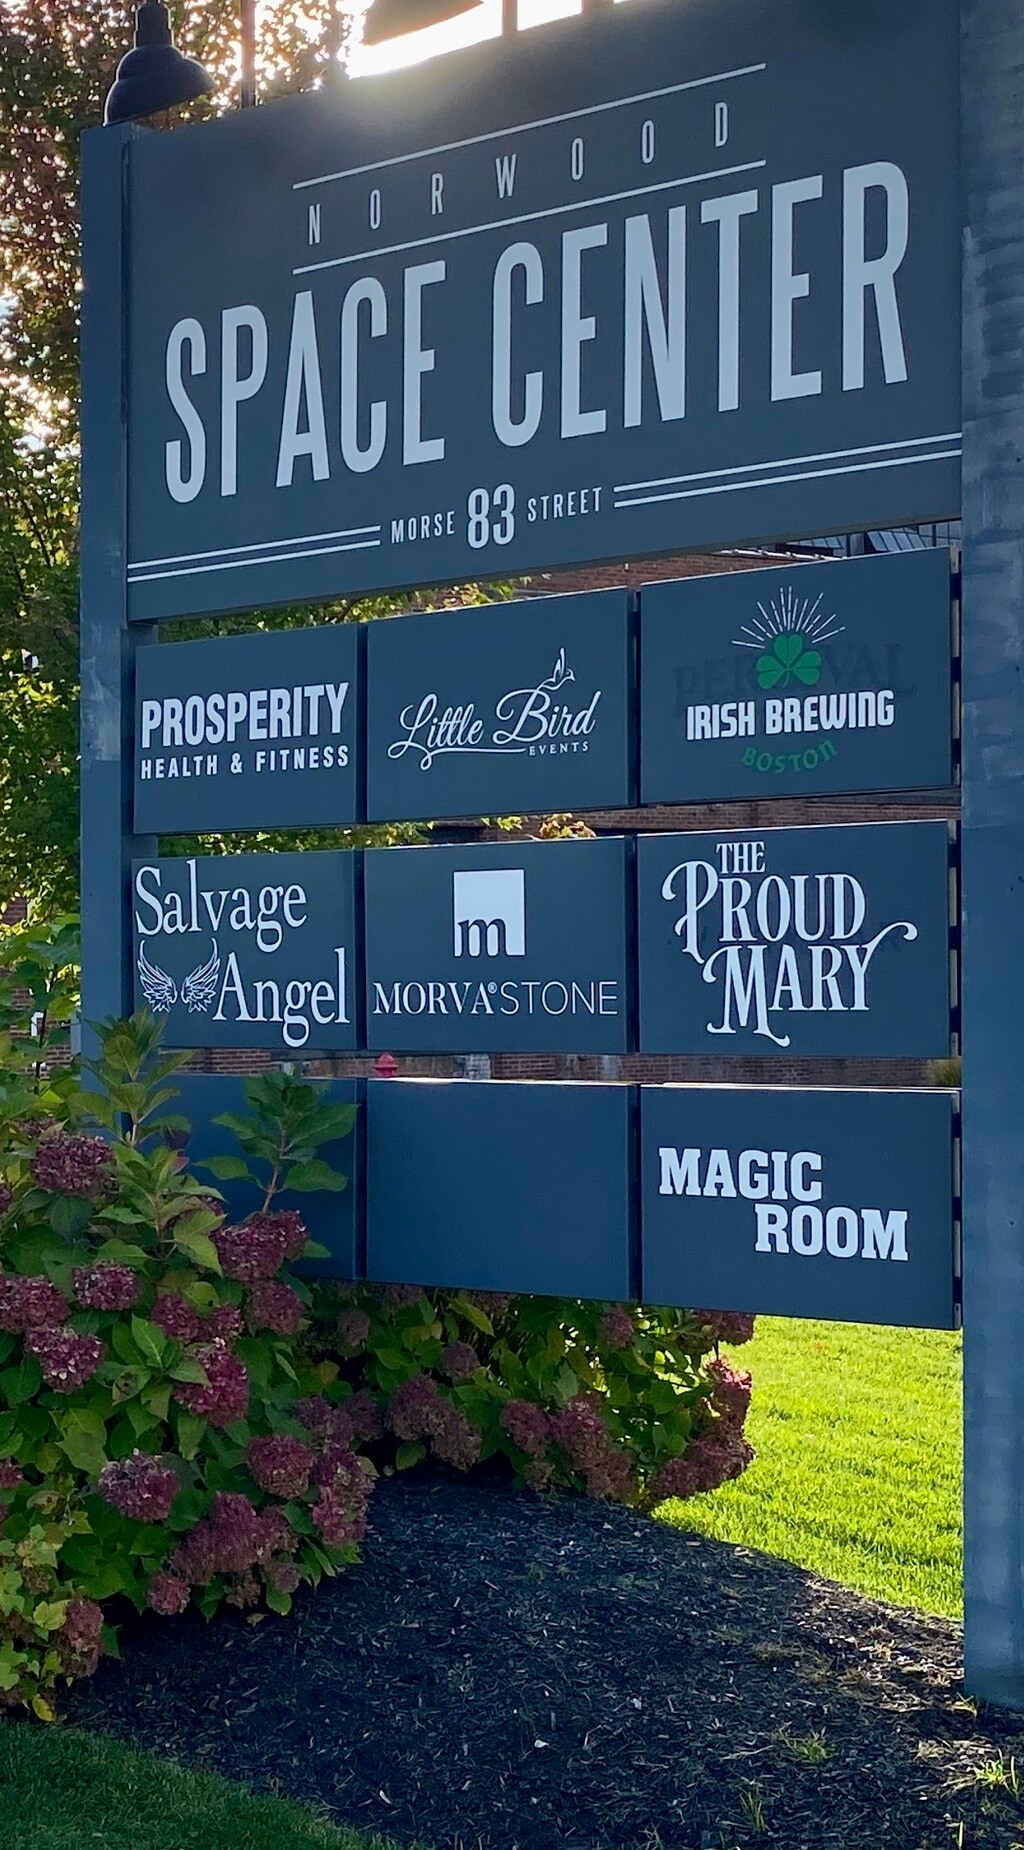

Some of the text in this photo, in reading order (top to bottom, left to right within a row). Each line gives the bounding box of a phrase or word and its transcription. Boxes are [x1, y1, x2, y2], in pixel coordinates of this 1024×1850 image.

[308, 102, 728, 245] NORWOOD
[165, 161, 909, 503] SPACE CENTER
[391, 483, 602, 549] MORSE 83 STREET
[141, 682, 349, 749] PROSPERITY
[387, 684, 602, 771] Little Bird
[529, 740, 589, 756] EVENTS
[686, 689, 895, 741] IRISH BREWING
[141, 745, 349, 780] HEALTH & FITNESS
[715, 841, 766, 874] THE
[135, 858, 307, 953] Salvage
[661, 860, 866, 964] PROUD
[212, 947, 351, 1048] Angel
[699, 921, 918, 1047] MARY
[658, 1147, 822, 1202] MAGIC
[754, 1203, 909, 1261] ROOM
